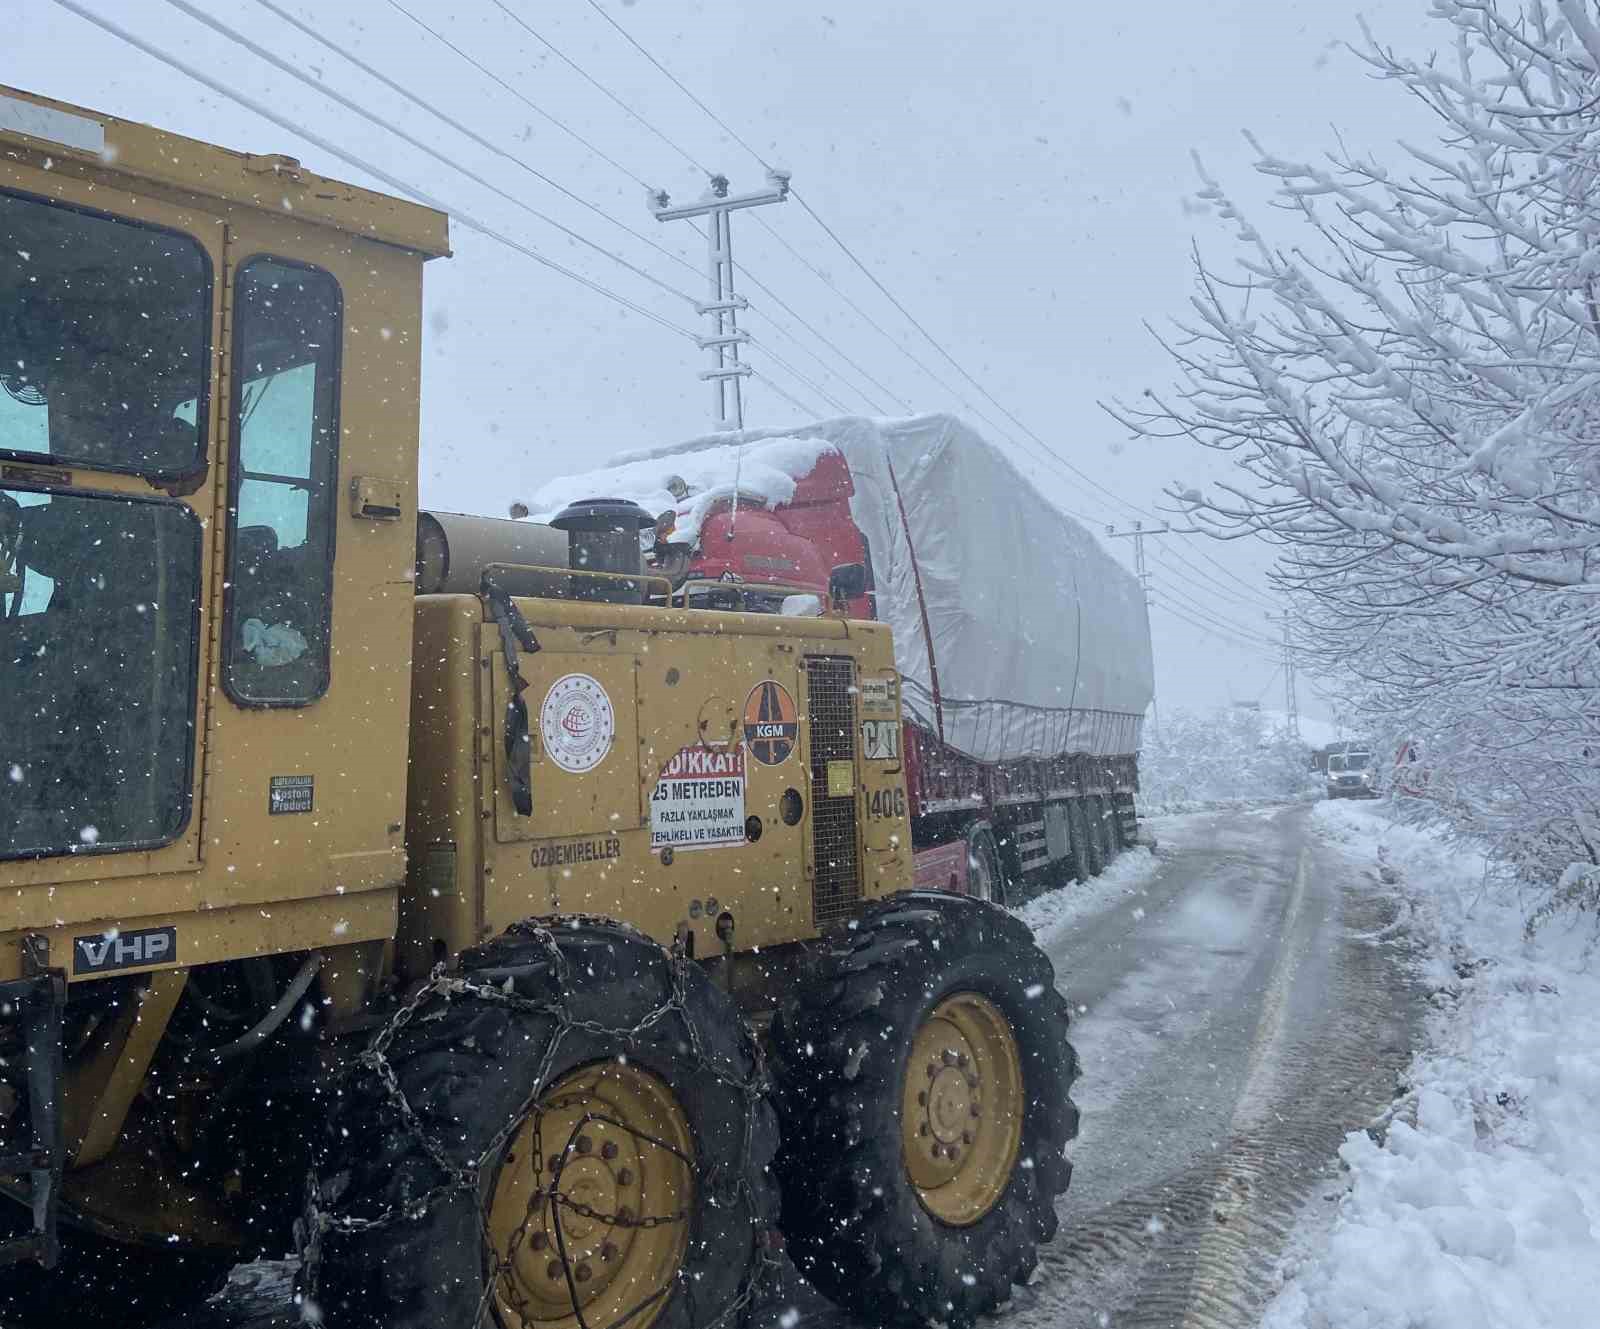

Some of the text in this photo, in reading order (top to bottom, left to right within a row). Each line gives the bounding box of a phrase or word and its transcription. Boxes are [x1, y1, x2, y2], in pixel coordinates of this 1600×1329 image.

[757, 725, 784, 737] KGM
[864, 720, 897, 759] CAT
[653, 780, 740, 801] 25 METREDEN
[272, 800, 312, 812] Product
[660, 807, 734, 823] FAZLA YAKLAŞMAK
[694, 829, 705, 840] VE
[708, 825, 744, 838] YASAKTIR
[79, 932, 170, 967] VHP
